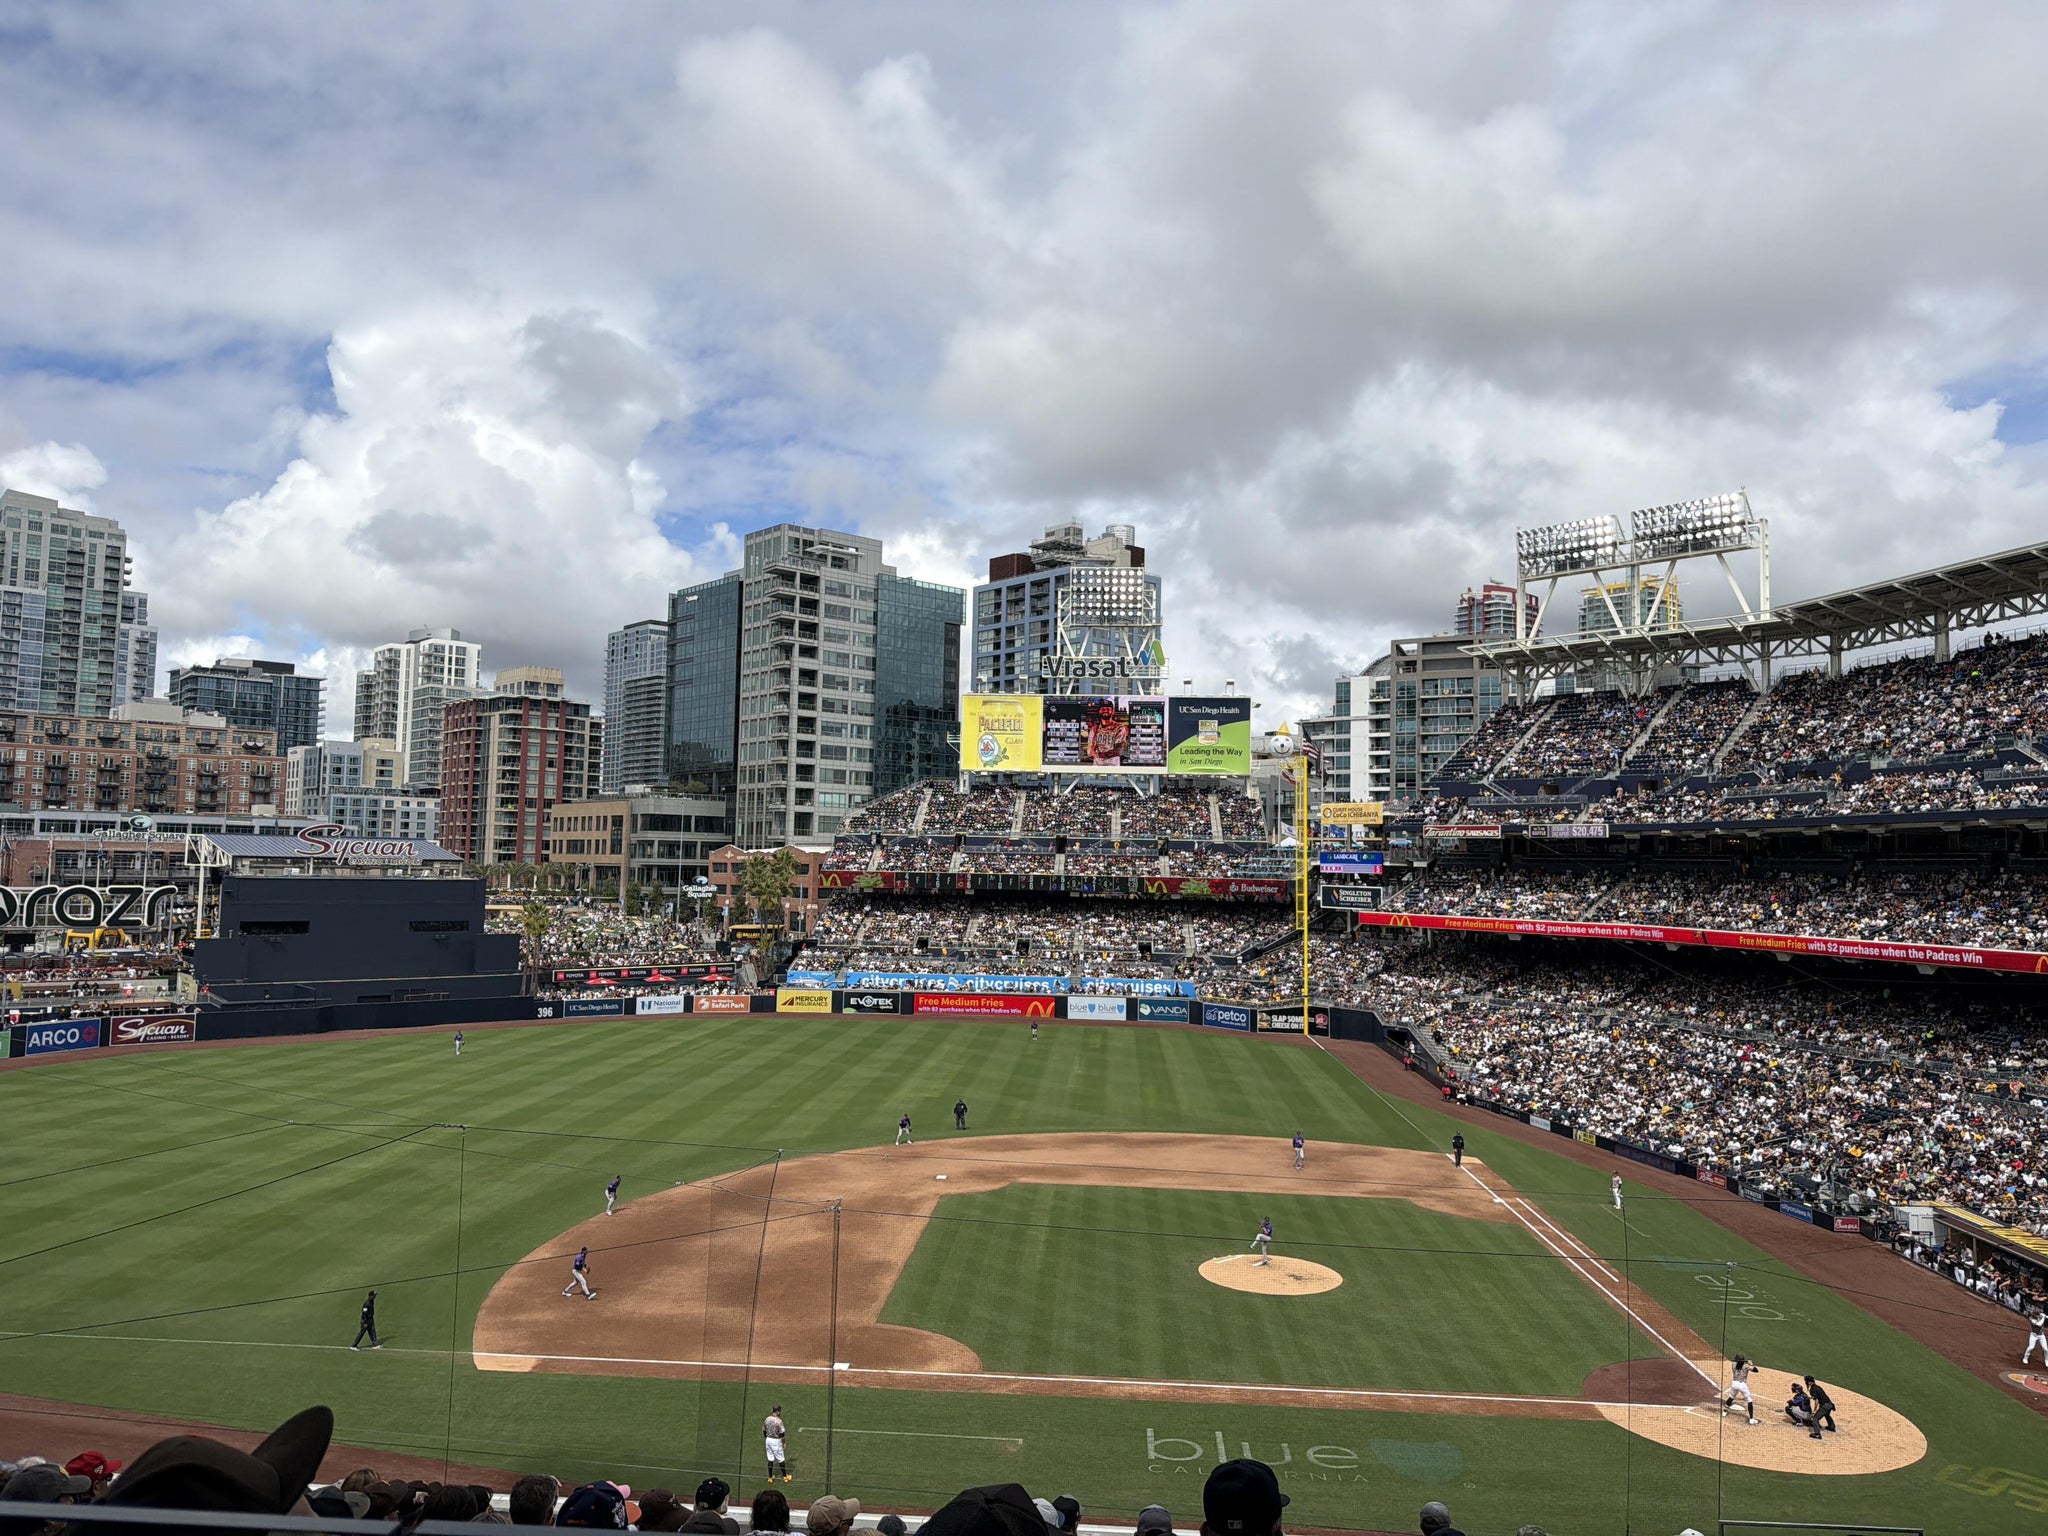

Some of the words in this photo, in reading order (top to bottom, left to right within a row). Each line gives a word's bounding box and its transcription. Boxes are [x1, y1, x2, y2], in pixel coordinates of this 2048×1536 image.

[1046, 656, 1129, 677] Viasat
[1202, 706, 1219, 715] Diego
[1180, 748, 1210, 756] Leading
[1226, 748, 1243, 757] Way
[1204, 758, 1222, 766] Diego
[92, 828, 148, 841] Gallagher
[148, 830, 186, 841] Square
[1425, 827, 1465, 836] Tarantino
[1572, 826, 1604, 836] $20,475
[295, 824, 418, 865] Sycuan
[1240, 884, 1278, 894] Budweiser
[23, 884, 178, 928] razr
[1444, 919, 1462, 928] Free
[1462, 920, 1494, 929] Medium
[1495, 922, 1514, 930] Fries
[1516, 922, 1534, 931] with
[1536, 923, 1546, 932] $2
[1547, 924, 1586, 935] purchase
[1588, 926, 1612, 935] when
[1614, 927, 1628, 936] the
[1630, 928, 1651, 937] Padres
[1652, 930, 1664, 938] Win
[1739, 936, 1755, 946] Free
[1756, 937, 1786, 948] Medium
[1787, 939, 1806, 950] Fries
[1808, 941, 1826, 952] with
[1827, 942, 1838, 952] $2
[1840, 944, 1880, 957] purchase
[1881, 946, 1906, 958] when
[1908, 948, 1924, 959] the
[1926, 949, 1960, 962] Padres
[1962, 951, 1983, 964] Win
[862, 974, 944, 989] citycrises
[919, 997, 939, 1006] Free
[941, 998, 978, 1006] Medium
[981, 998, 1004, 1007] Fries
[1069, 1002, 1088, 1011] blue
[1098, 1004, 1116, 1012] blue
[537, 1006, 553, 1018] 396
[1151, 1006, 1188, 1014] VANDA
[1218, 1010, 1246, 1022] petco
[117, 1018, 187, 1042] Sycuan
[28, 1028, 80, 1048] ARCO
[1146, 1428, 1359, 1469] blue
[1148, 1464, 1368, 1482] CALRNIA
